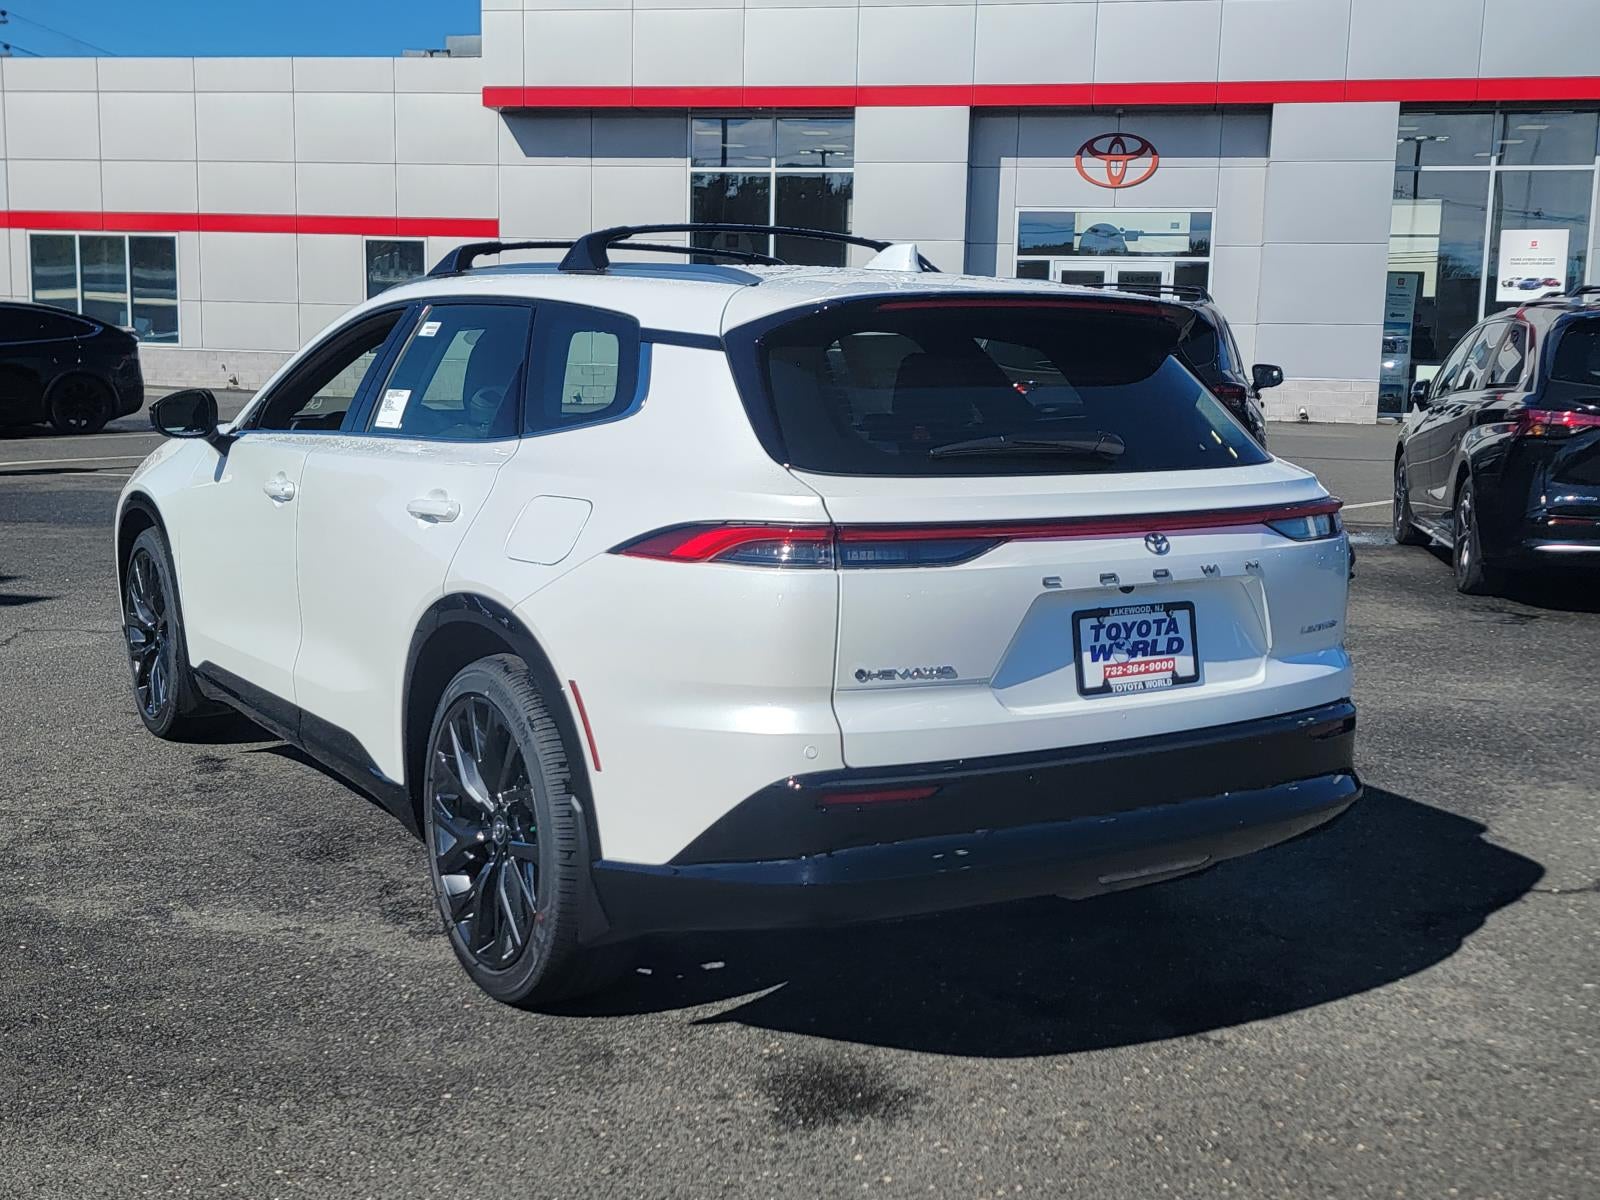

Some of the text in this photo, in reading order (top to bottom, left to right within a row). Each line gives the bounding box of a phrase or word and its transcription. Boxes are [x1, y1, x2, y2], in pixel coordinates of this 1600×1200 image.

[1042, 560, 1260, 588] CROWN
[1109, 603, 1165, 616] LAKEWOOD, NJ
[1090, 617, 1179, 642] TOYOTA
[1112, 678, 1173, 693] TOYOTA WORLD
